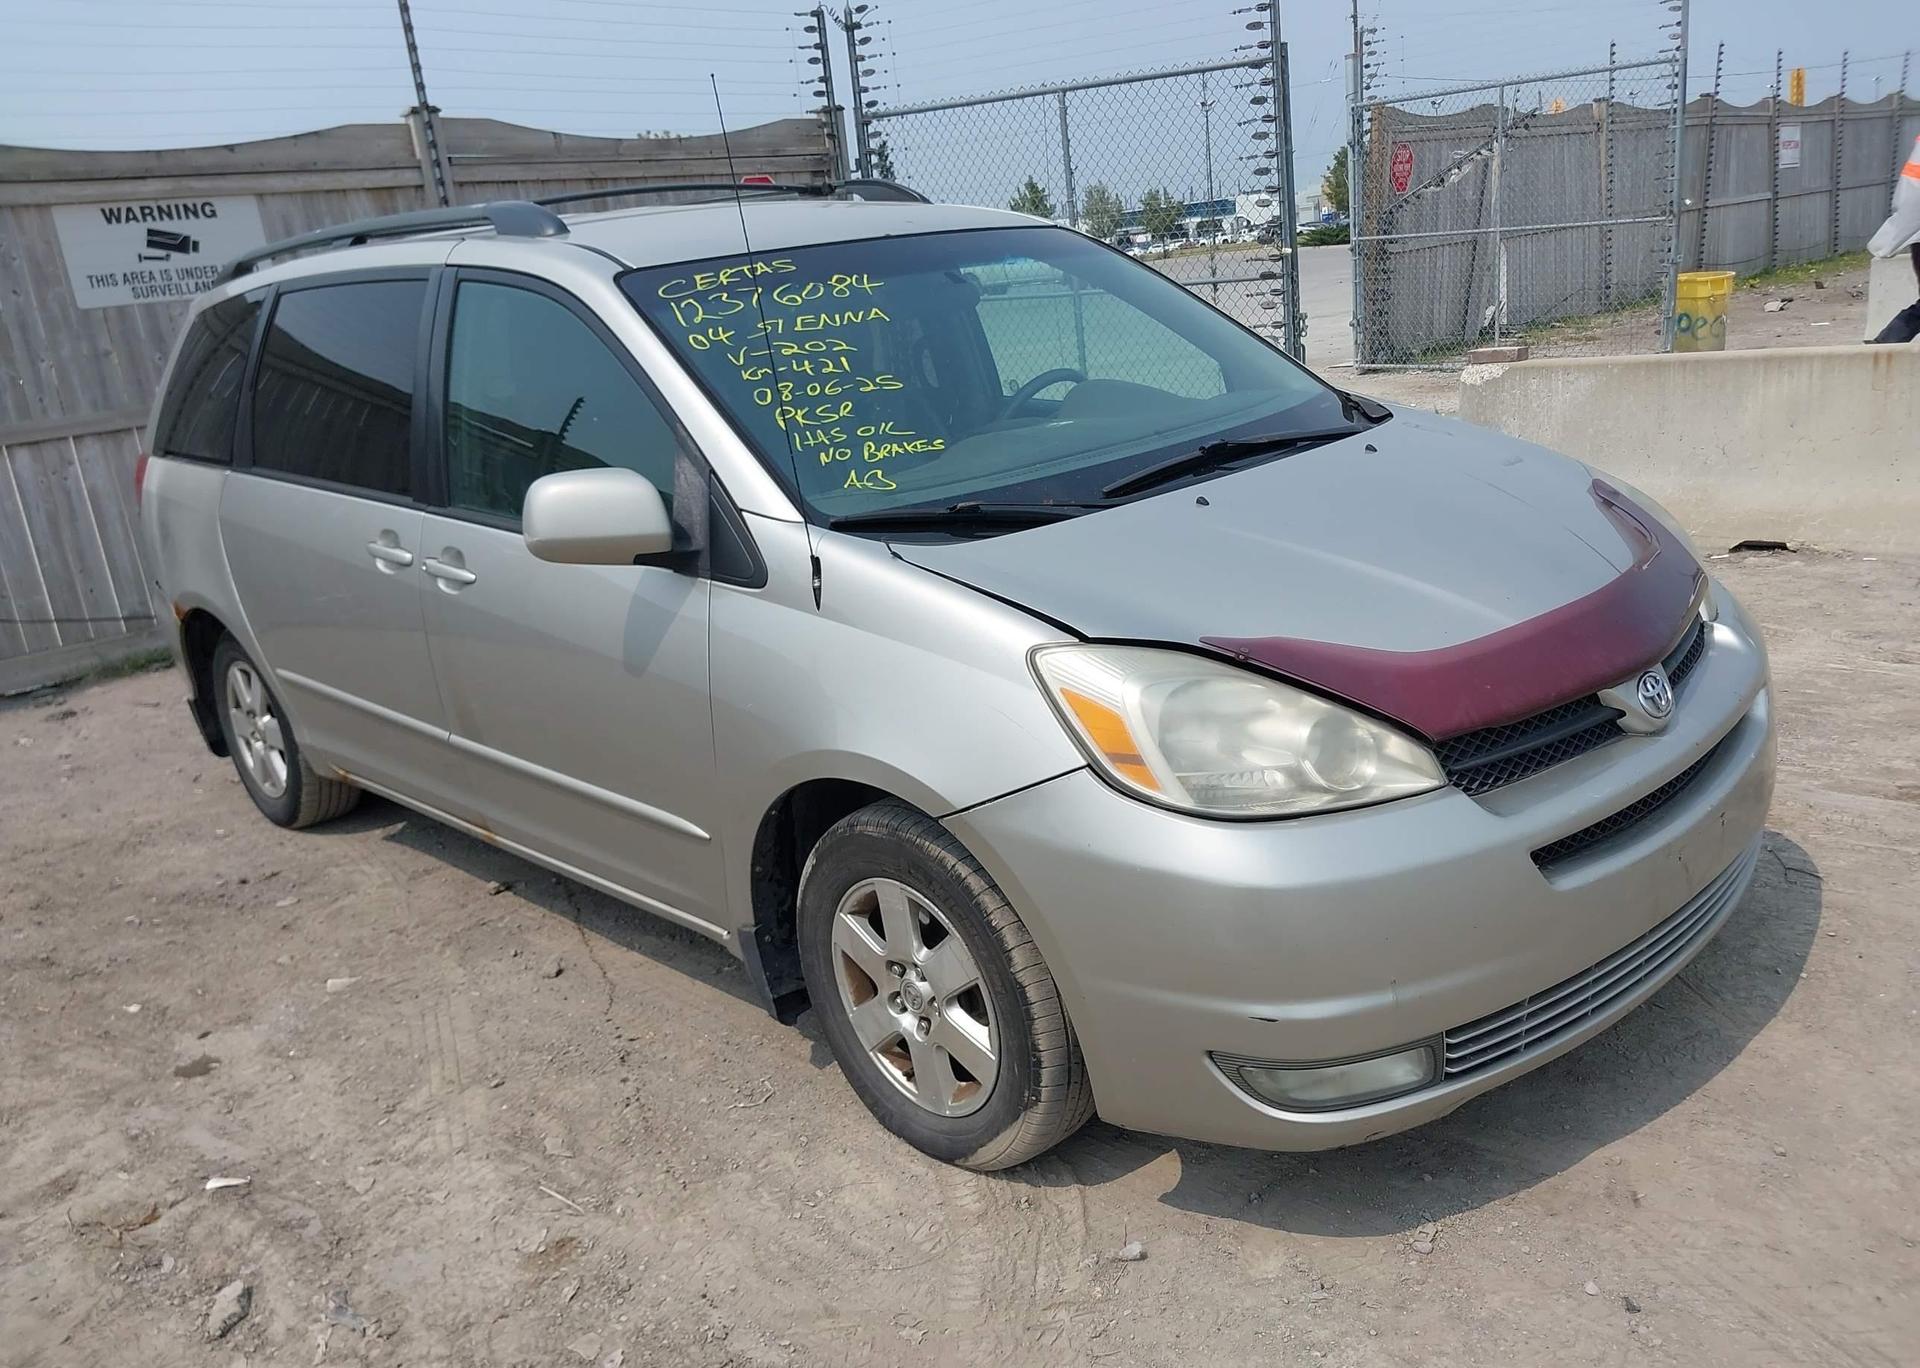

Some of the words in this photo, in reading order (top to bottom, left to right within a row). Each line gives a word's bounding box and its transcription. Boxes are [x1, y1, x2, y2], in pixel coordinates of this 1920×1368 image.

[101, 201, 218, 225] WARNING
[86, 272, 118, 290] THIS
[122, 268, 155, 286] AREA
[160, 266, 173, 282] IS
[178, 264, 219, 282] UNDER
[131, 279, 216, 299] SURVEILLAN
[658, 259, 797, 299] CERTAS
[688, 327, 736, 350] 04
[794, 427, 847, 451] HAS
[856, 422, 916, 438] OIL
[819, 447, 851, 466] NO
[863, 438, 946, 463] BRAKES
